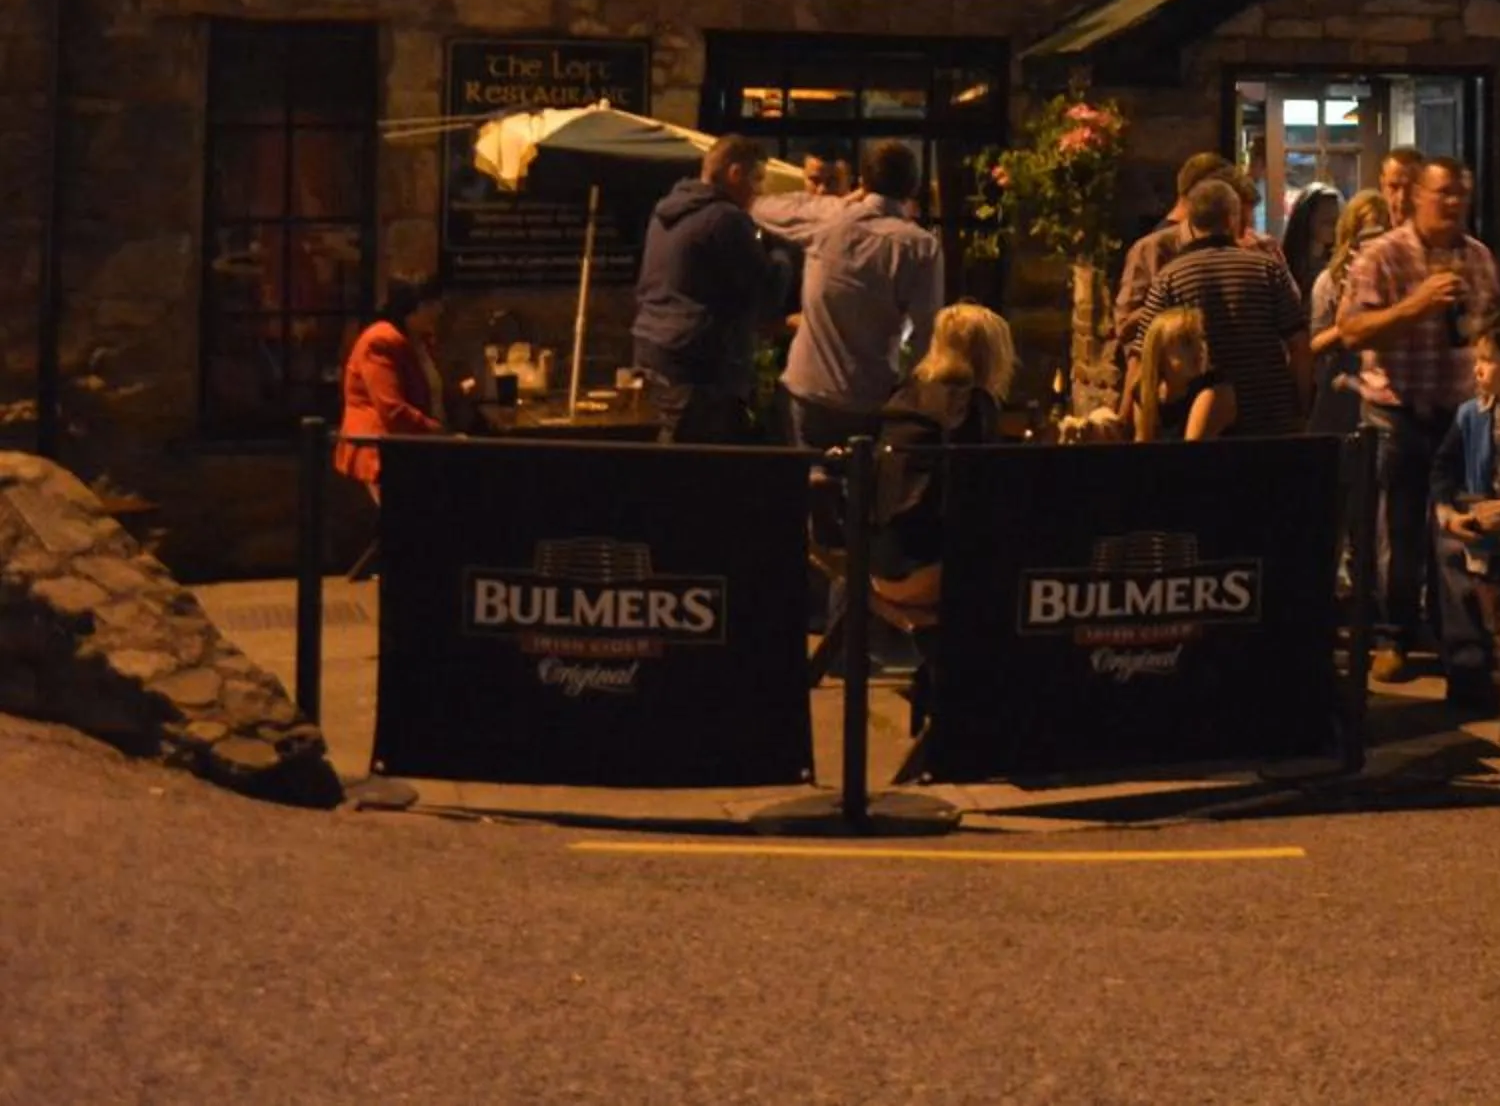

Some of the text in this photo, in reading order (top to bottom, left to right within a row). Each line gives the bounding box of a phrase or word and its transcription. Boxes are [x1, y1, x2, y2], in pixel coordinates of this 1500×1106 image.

[485, 52, 543, 79] The
[472, 578, 718, 633] BULMERS
[1027, 570, 1252, 624] BULMERS
